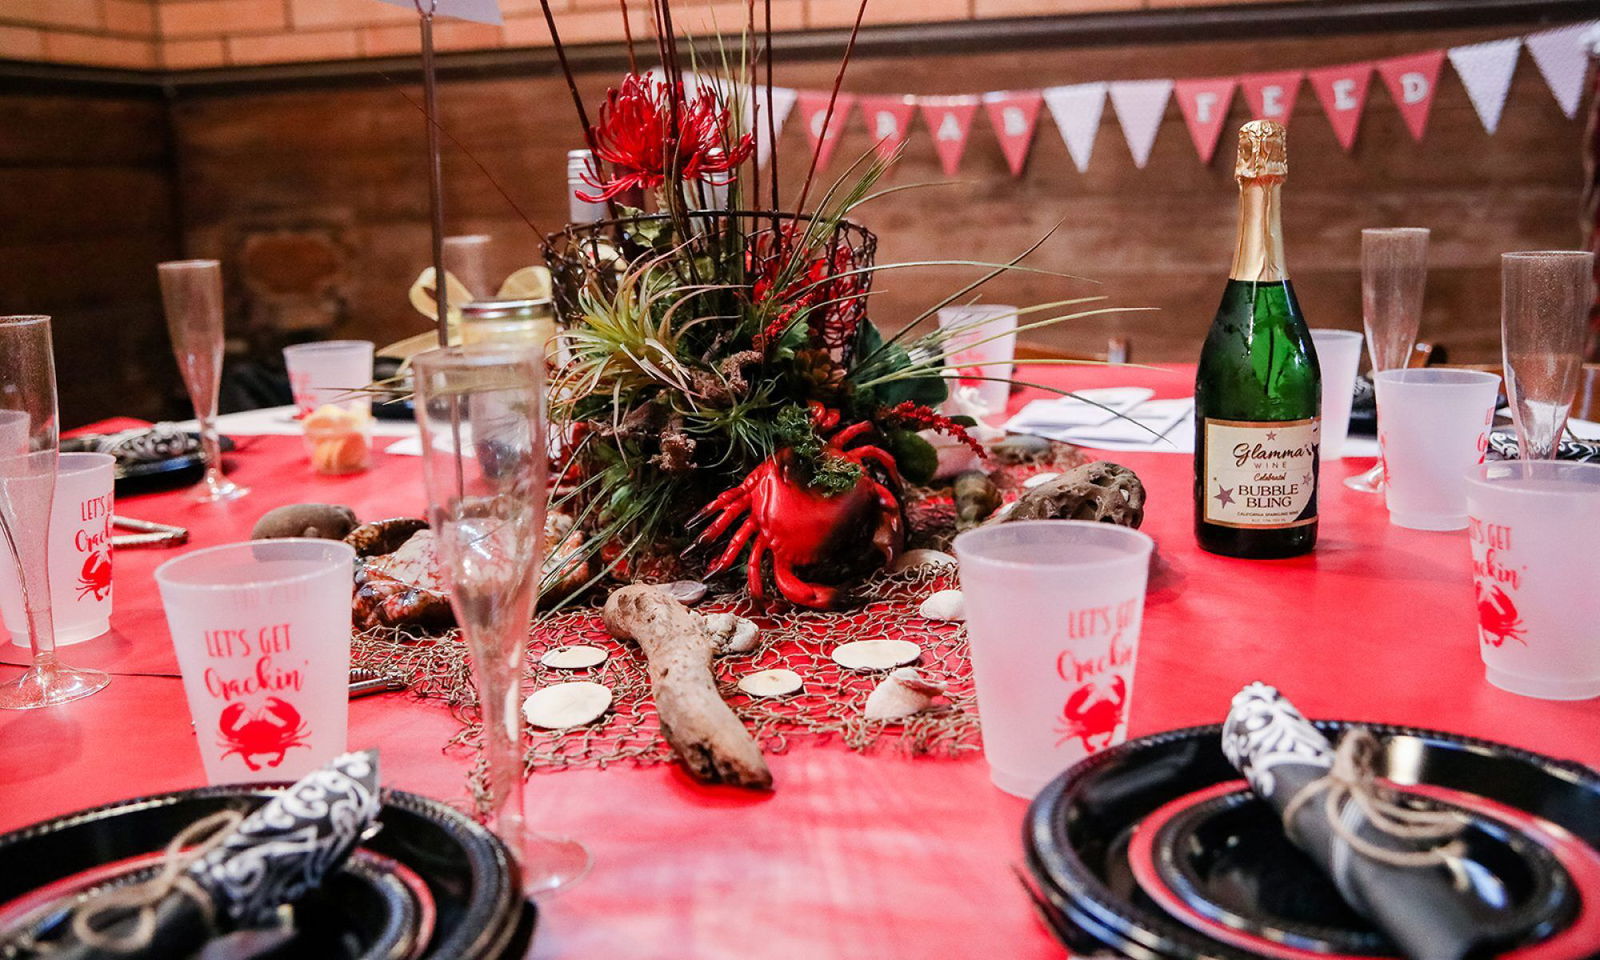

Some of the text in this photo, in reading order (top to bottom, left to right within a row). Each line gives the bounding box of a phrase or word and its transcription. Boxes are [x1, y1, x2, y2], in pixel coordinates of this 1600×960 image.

[1196, 71, 1428, 124] FEED
[1238, 483, 1299, 496] BUBBLE
[1246, 497, 1292, 508] BLING
[81, 495, 105, 521] LET'S
[1487, 523, 1512, 551] GET
[1068, 606, 1112, 639] LET'S
[204, 624, 291, 658] LET'S GET
[204, 655, 309, 701] Crackin'
